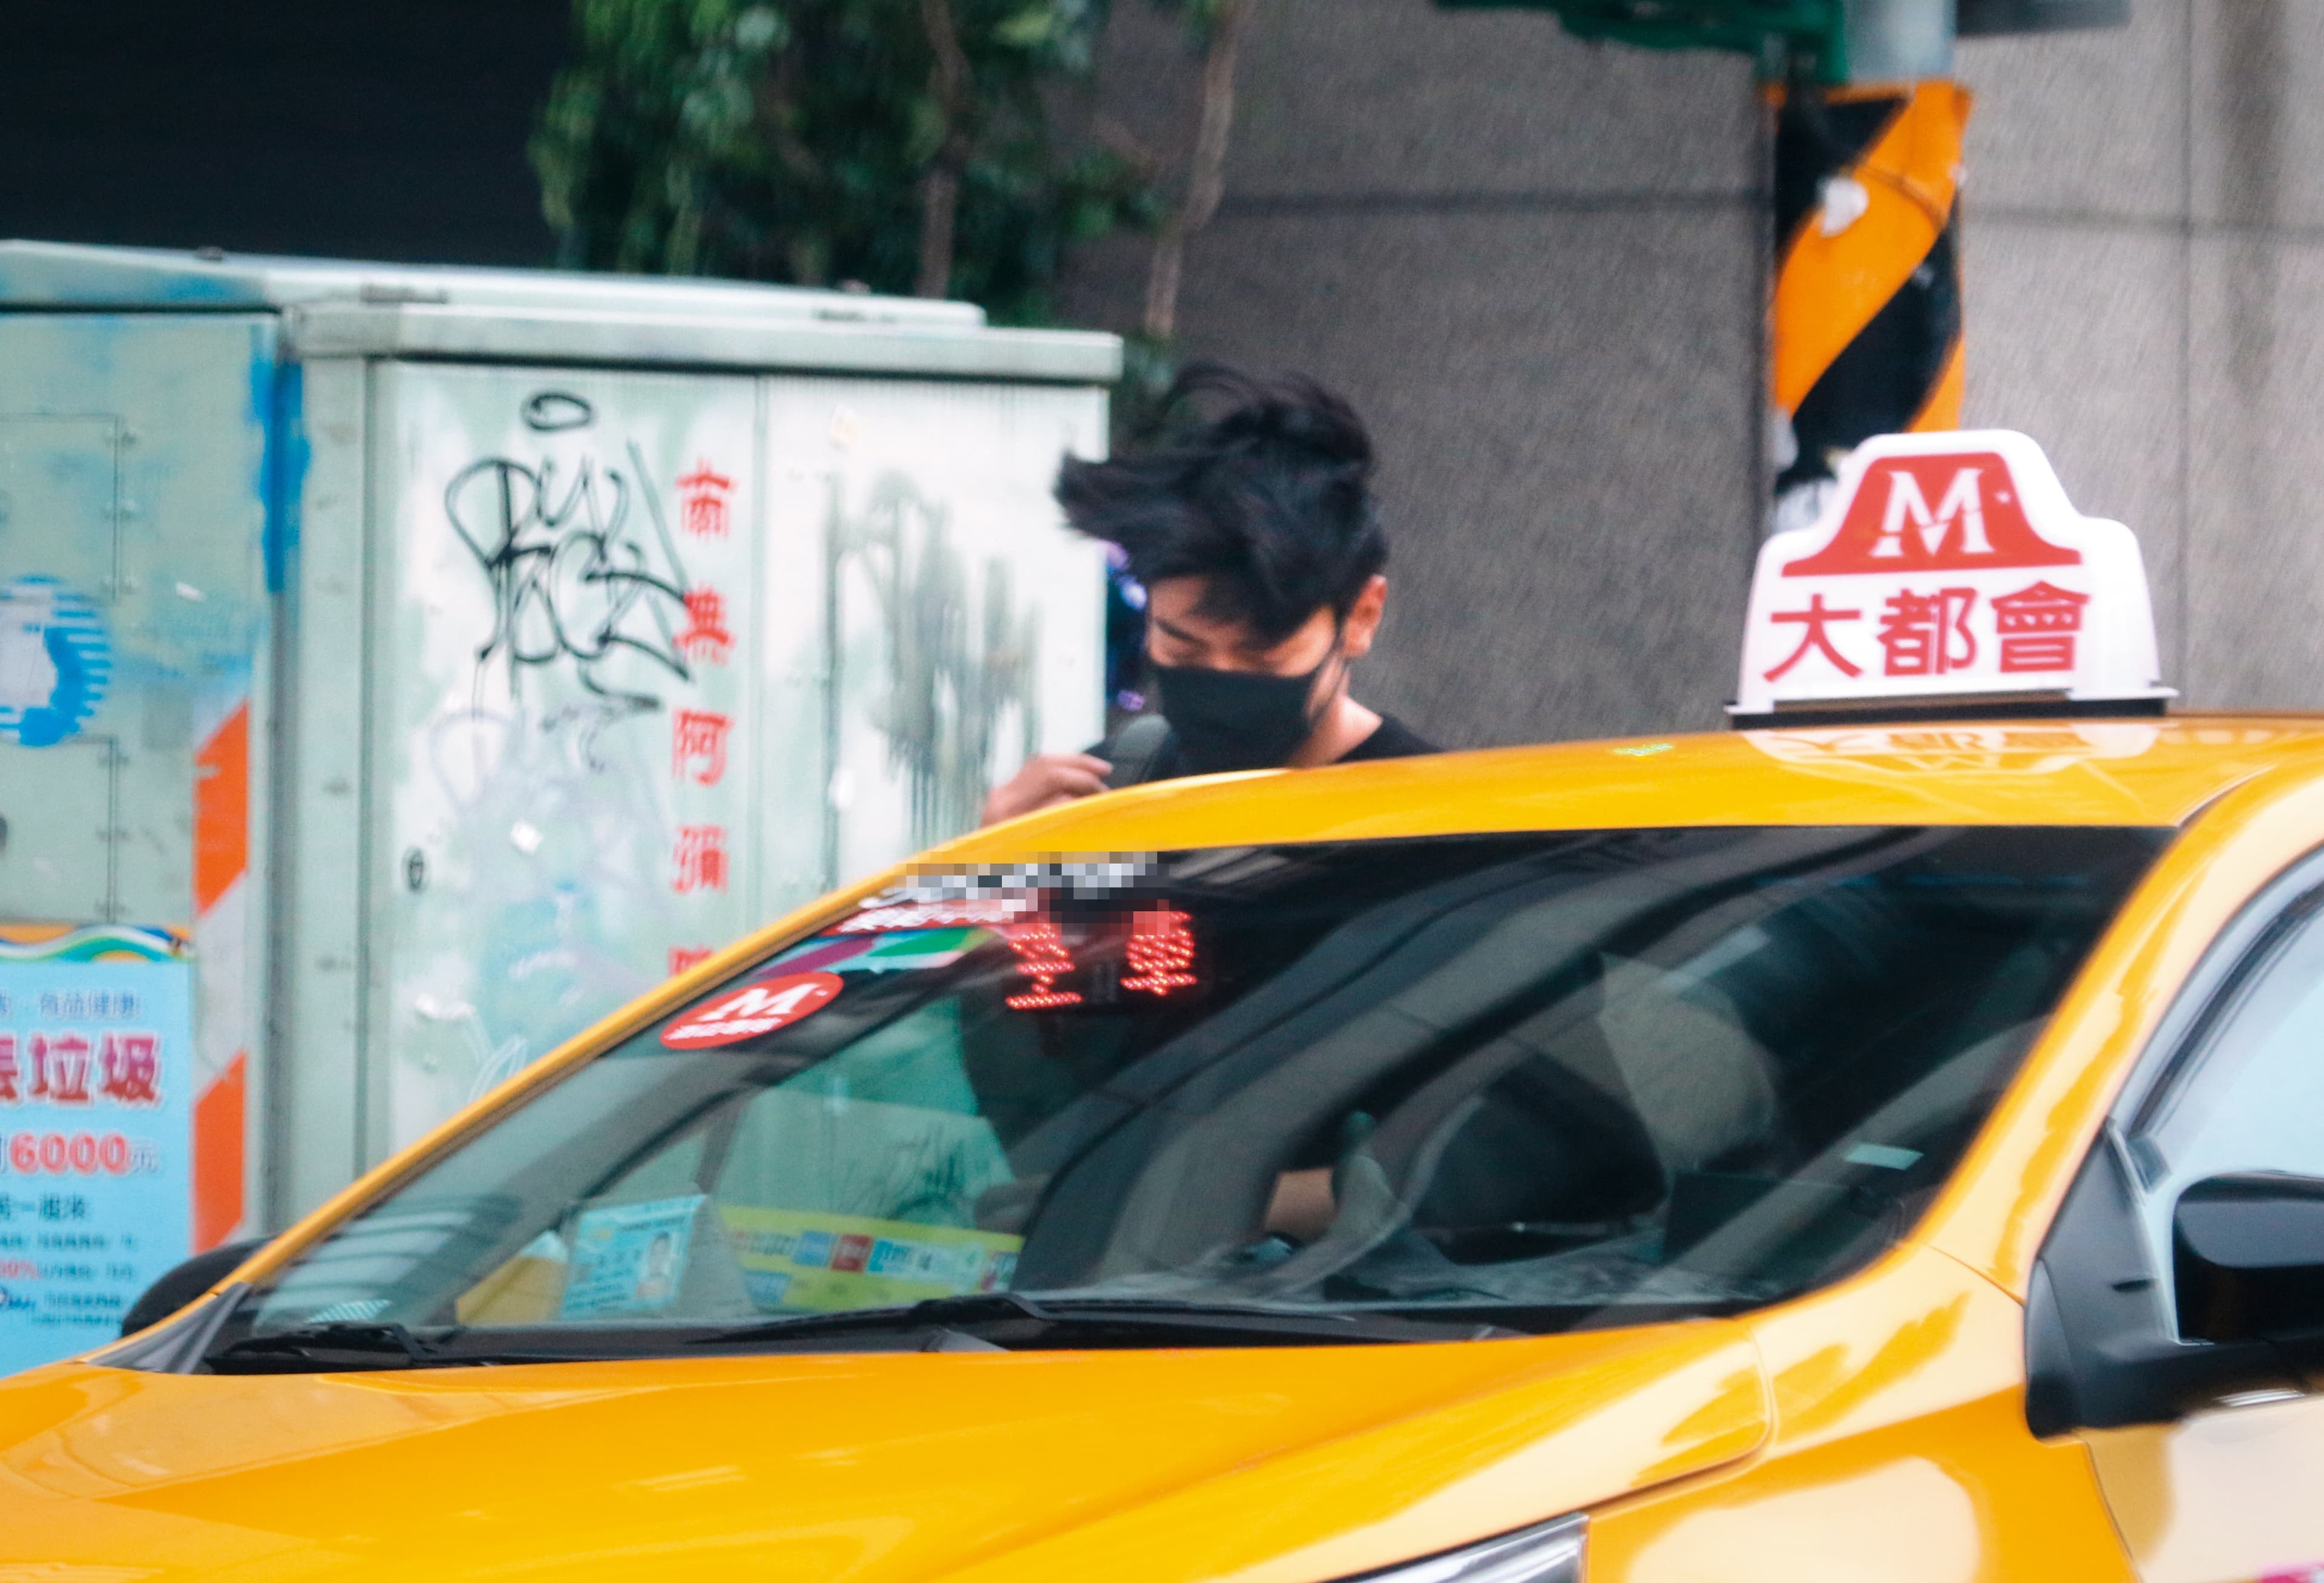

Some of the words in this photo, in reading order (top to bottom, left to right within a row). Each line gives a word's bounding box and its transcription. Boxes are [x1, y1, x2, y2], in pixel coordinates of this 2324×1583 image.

[1870, 467, 1996, 558] M
[1763, 581, 2090, 682] 大都會
[0, 1130, 160, 1175] 6000元
